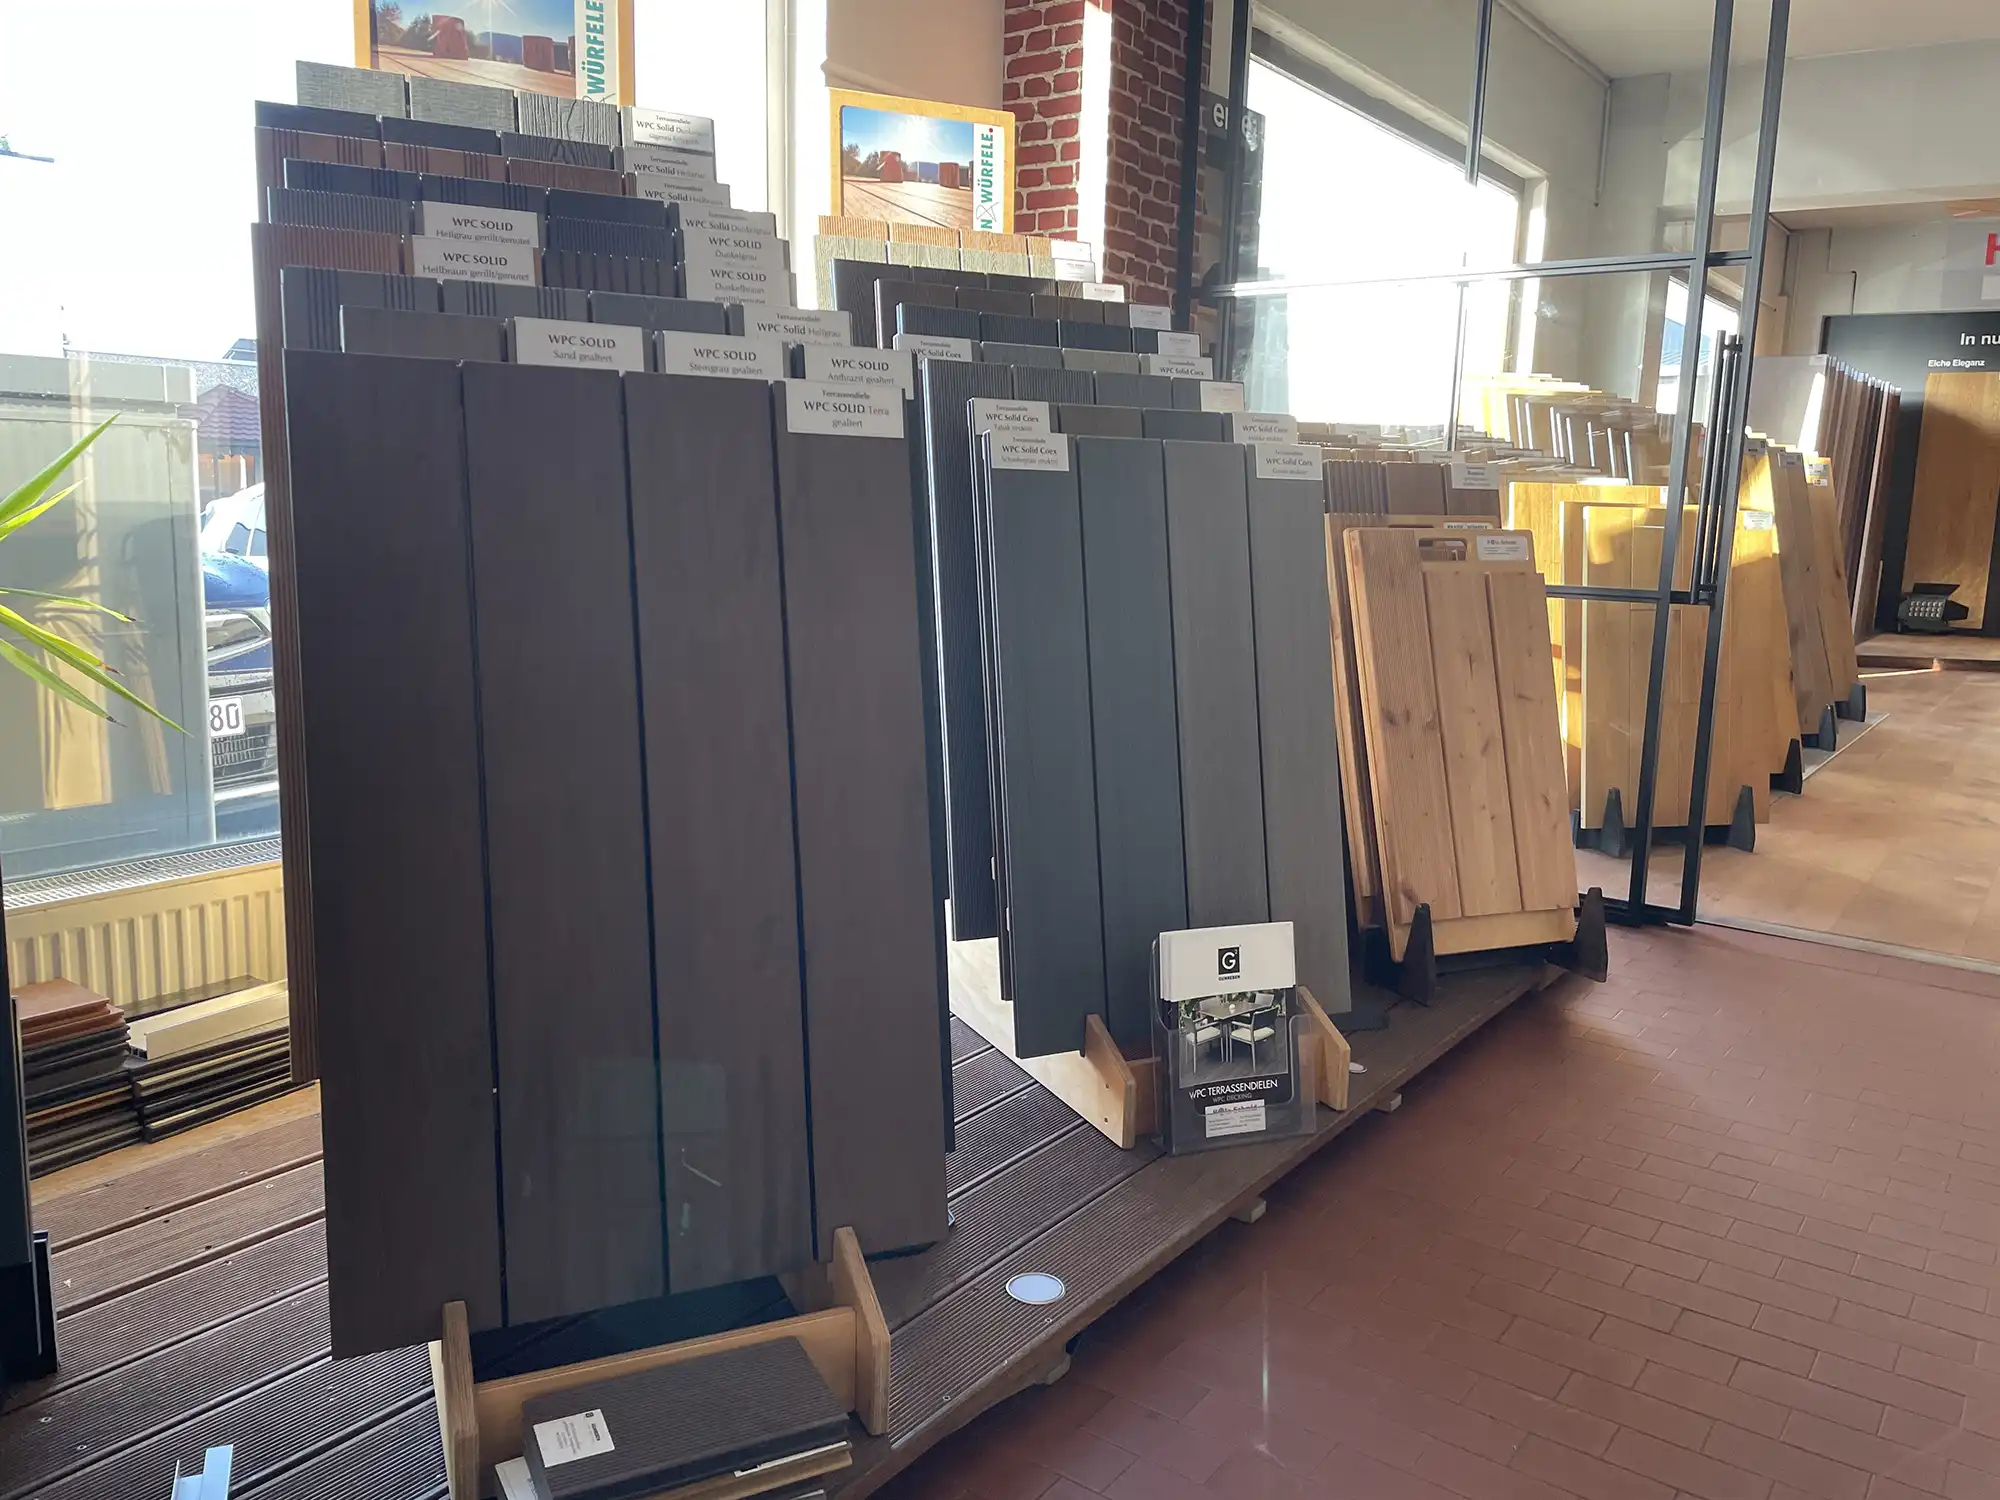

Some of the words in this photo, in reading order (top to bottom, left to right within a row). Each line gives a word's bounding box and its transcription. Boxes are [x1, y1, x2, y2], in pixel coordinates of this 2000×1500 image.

[636, 120, 655, 130] WPC
[656, 123, 675, 132] Solid
[634, 163, 655, 173] WPC
[655, 166, 675, 176] Solid
[644, 189, 666, 199] WPC
[667, 192, 688, 202] Solid
[452, 216, 478, 229] WPC
[480, 220, 513, 232] SOLID
[685, 218, 707, 229] WPC
[709, 221, 730, 231] Solid
[708, 236, 731, 247] WPC
[733, 239, 762, 250] SOLID
[443, 252, 471, 264] WPC
[473, 255, 508, 267] SOLID
[710, 268, 734, 280] WPC
[736, 271, 767, 282] SOLID
[756, 322, 781, 333] WPC
[783, 324, 806, 335] Solid
[548, 334, 577, 346] WPC
[579, 337, 616, 349] SOLID
[1960, 333, 1975, 346] In
[553, 350, 576, 361] Sand
[578, 351, 613, 364] gealtert
[693, 347, 720, 359] WPC
[722, 350, 757, 362] SOLID
[831, 358, 856, 370] WPC
[858, 360, 890, 372] SOLID
[803, 400, 831, 412] WPC
[832, 402, 866, 414] SOLID
[986, 413, 1003, 421] WPC
[1004, 413, 1021, 422] Solid
[1001, 445, 1020, 453] WPC
[1021, 446, 1038, 455] Solid
[1188, 1087, 1207, 1100] WPC
[1207, 1079, 1279, 1098] TERRASSENDIELEN
